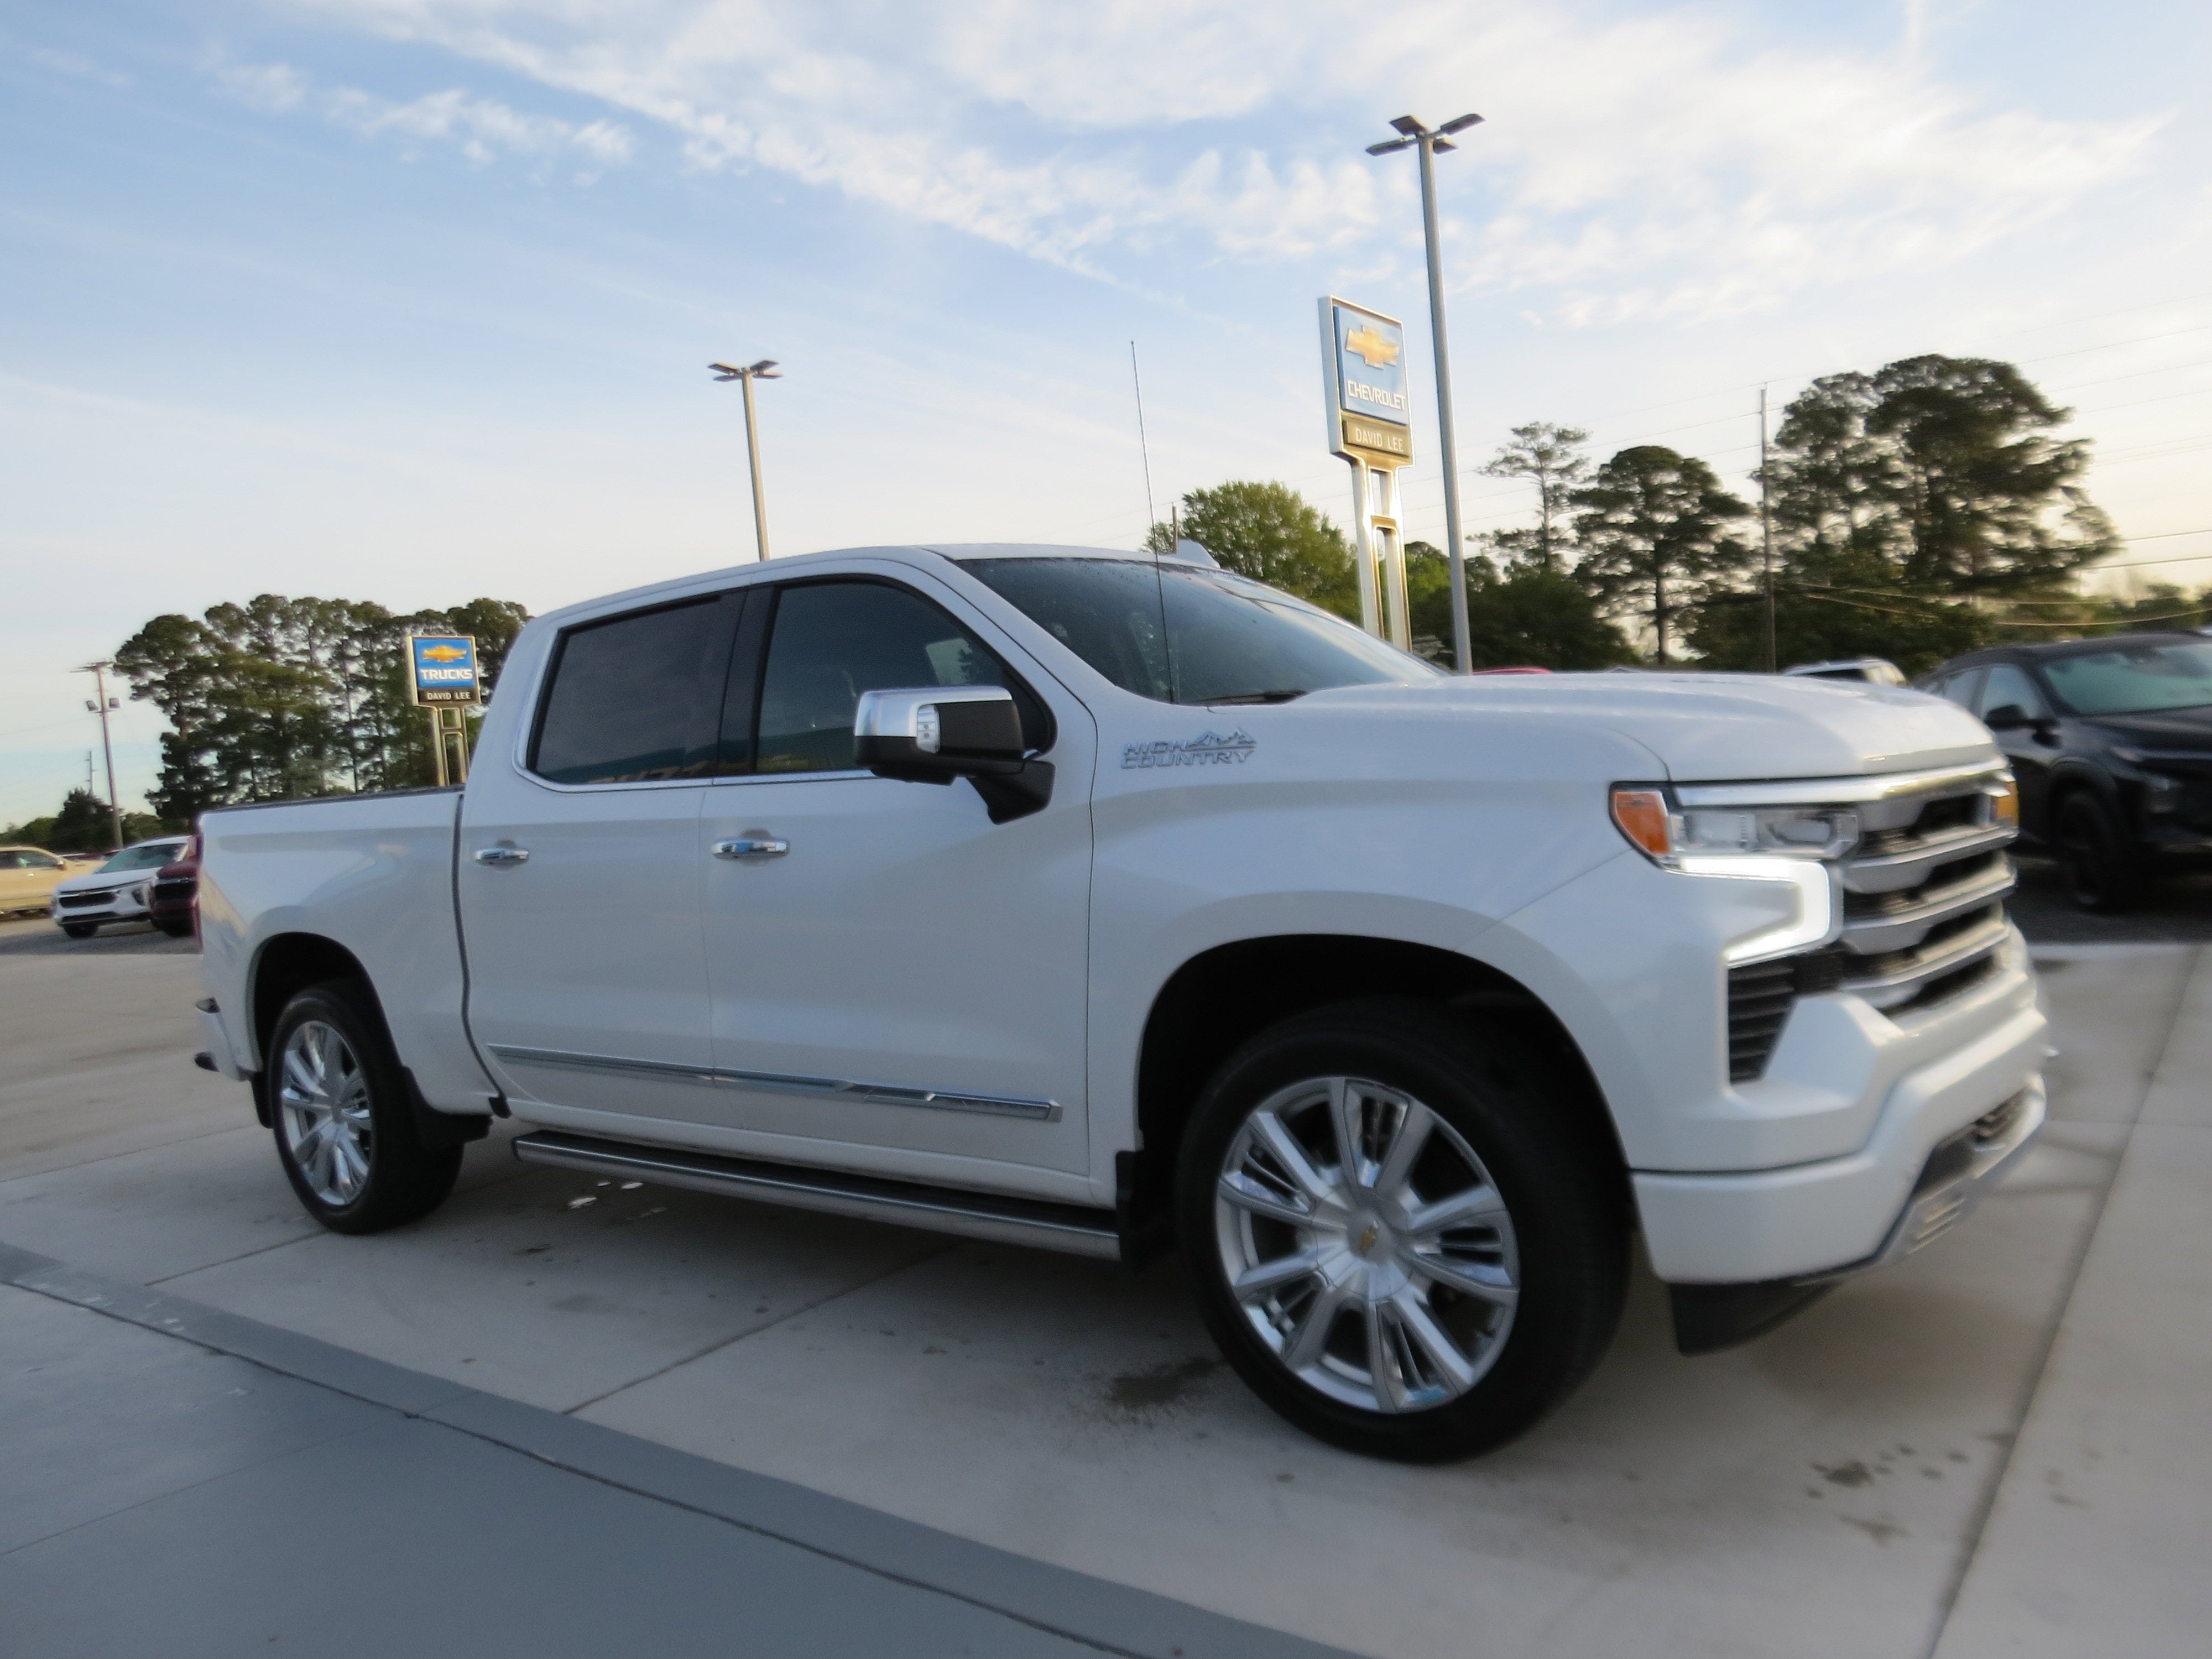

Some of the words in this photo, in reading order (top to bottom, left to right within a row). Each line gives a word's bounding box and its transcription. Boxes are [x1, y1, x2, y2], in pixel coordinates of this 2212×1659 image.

[1347, 379, 1406, 410] CHEVROLET
[1355, 427, 1383, 447] DAVID
[1387, 435, 1404, 452] LEE
[420, 669, 473, 680] TRUCKS
[427, 692, 452, 701] DAVID
[455, 691, 471, 700] LEE
[1120, 750, 1254, 769] COUNTRY
